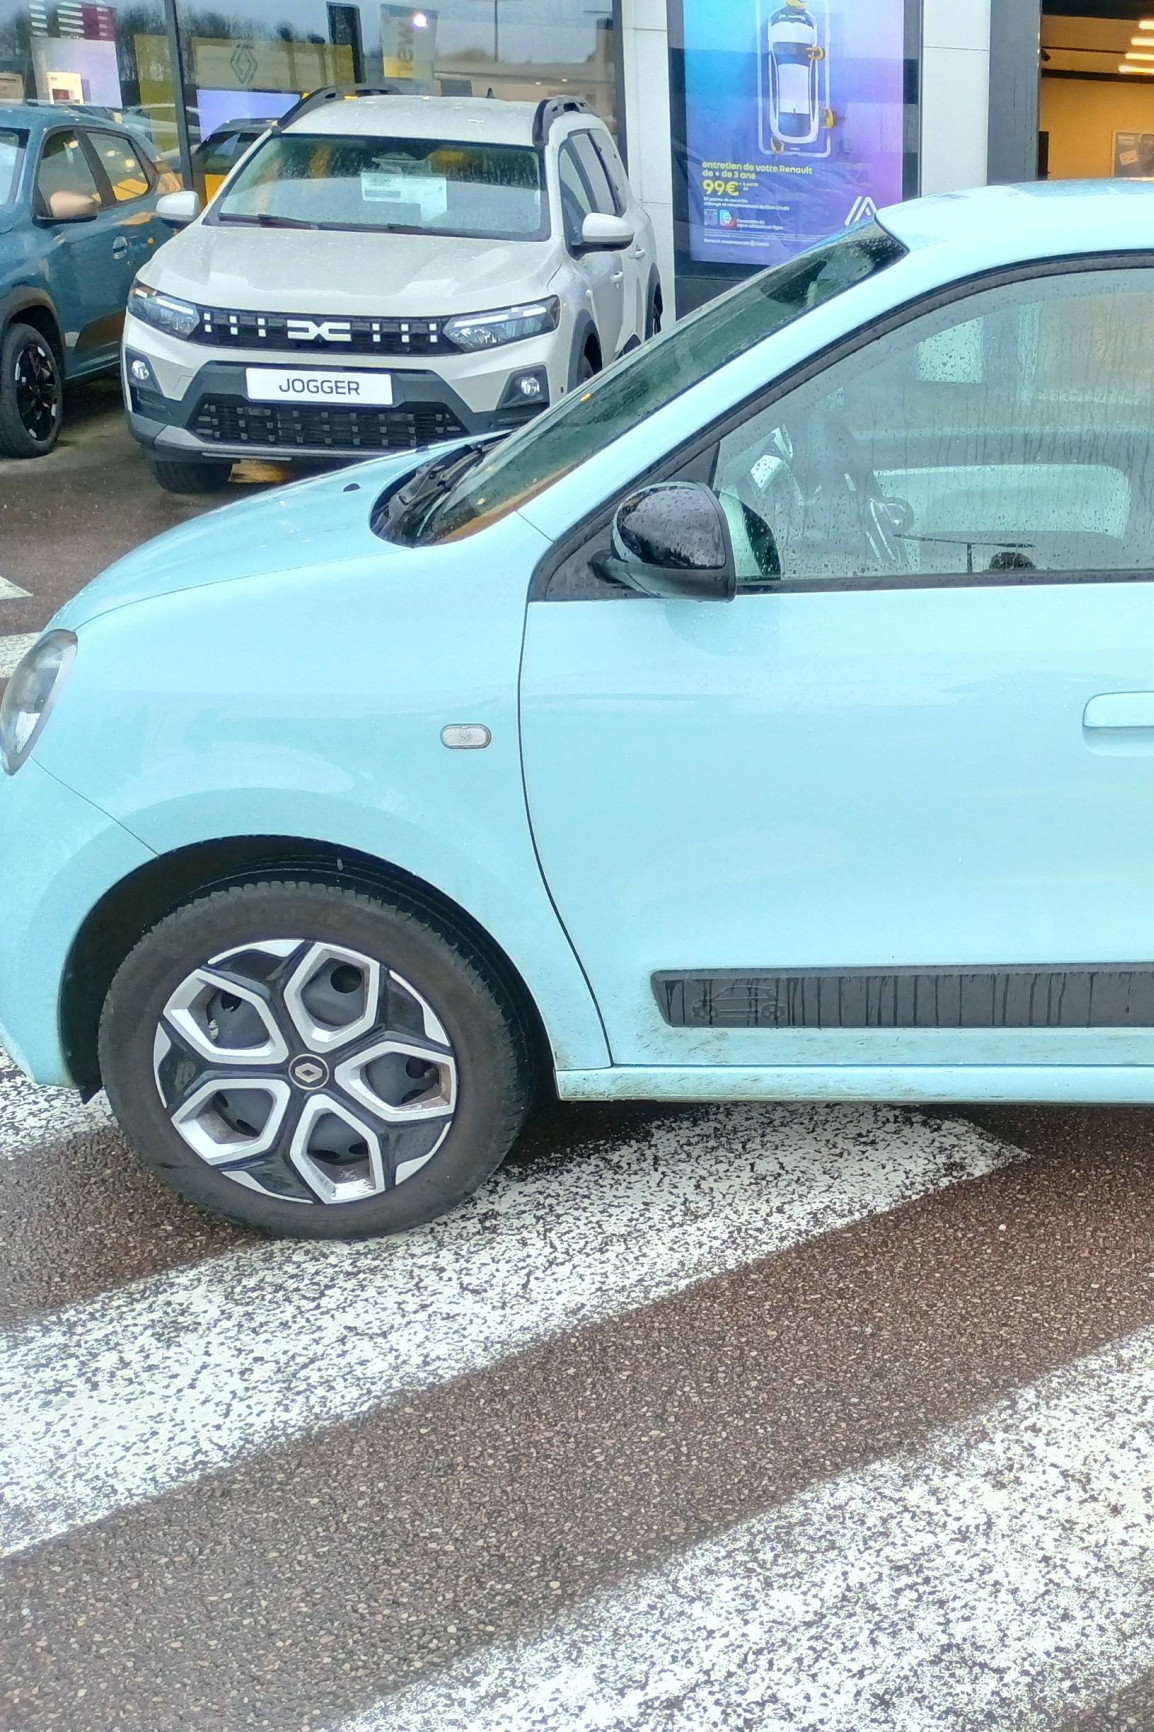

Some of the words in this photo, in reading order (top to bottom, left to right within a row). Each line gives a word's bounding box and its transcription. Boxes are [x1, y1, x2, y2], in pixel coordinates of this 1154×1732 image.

[702, 161, 742, 171] entretien
[743, 162, 755, 171] de
[755, 164, 779, 172] votre
[779, 165, 813, 175] Renault
[702, 169, 714, 177] de
[721, 170, 733, 178] de
[740, 172, 756, 180] ans
[278, 378, 361, 396] JOGGER
